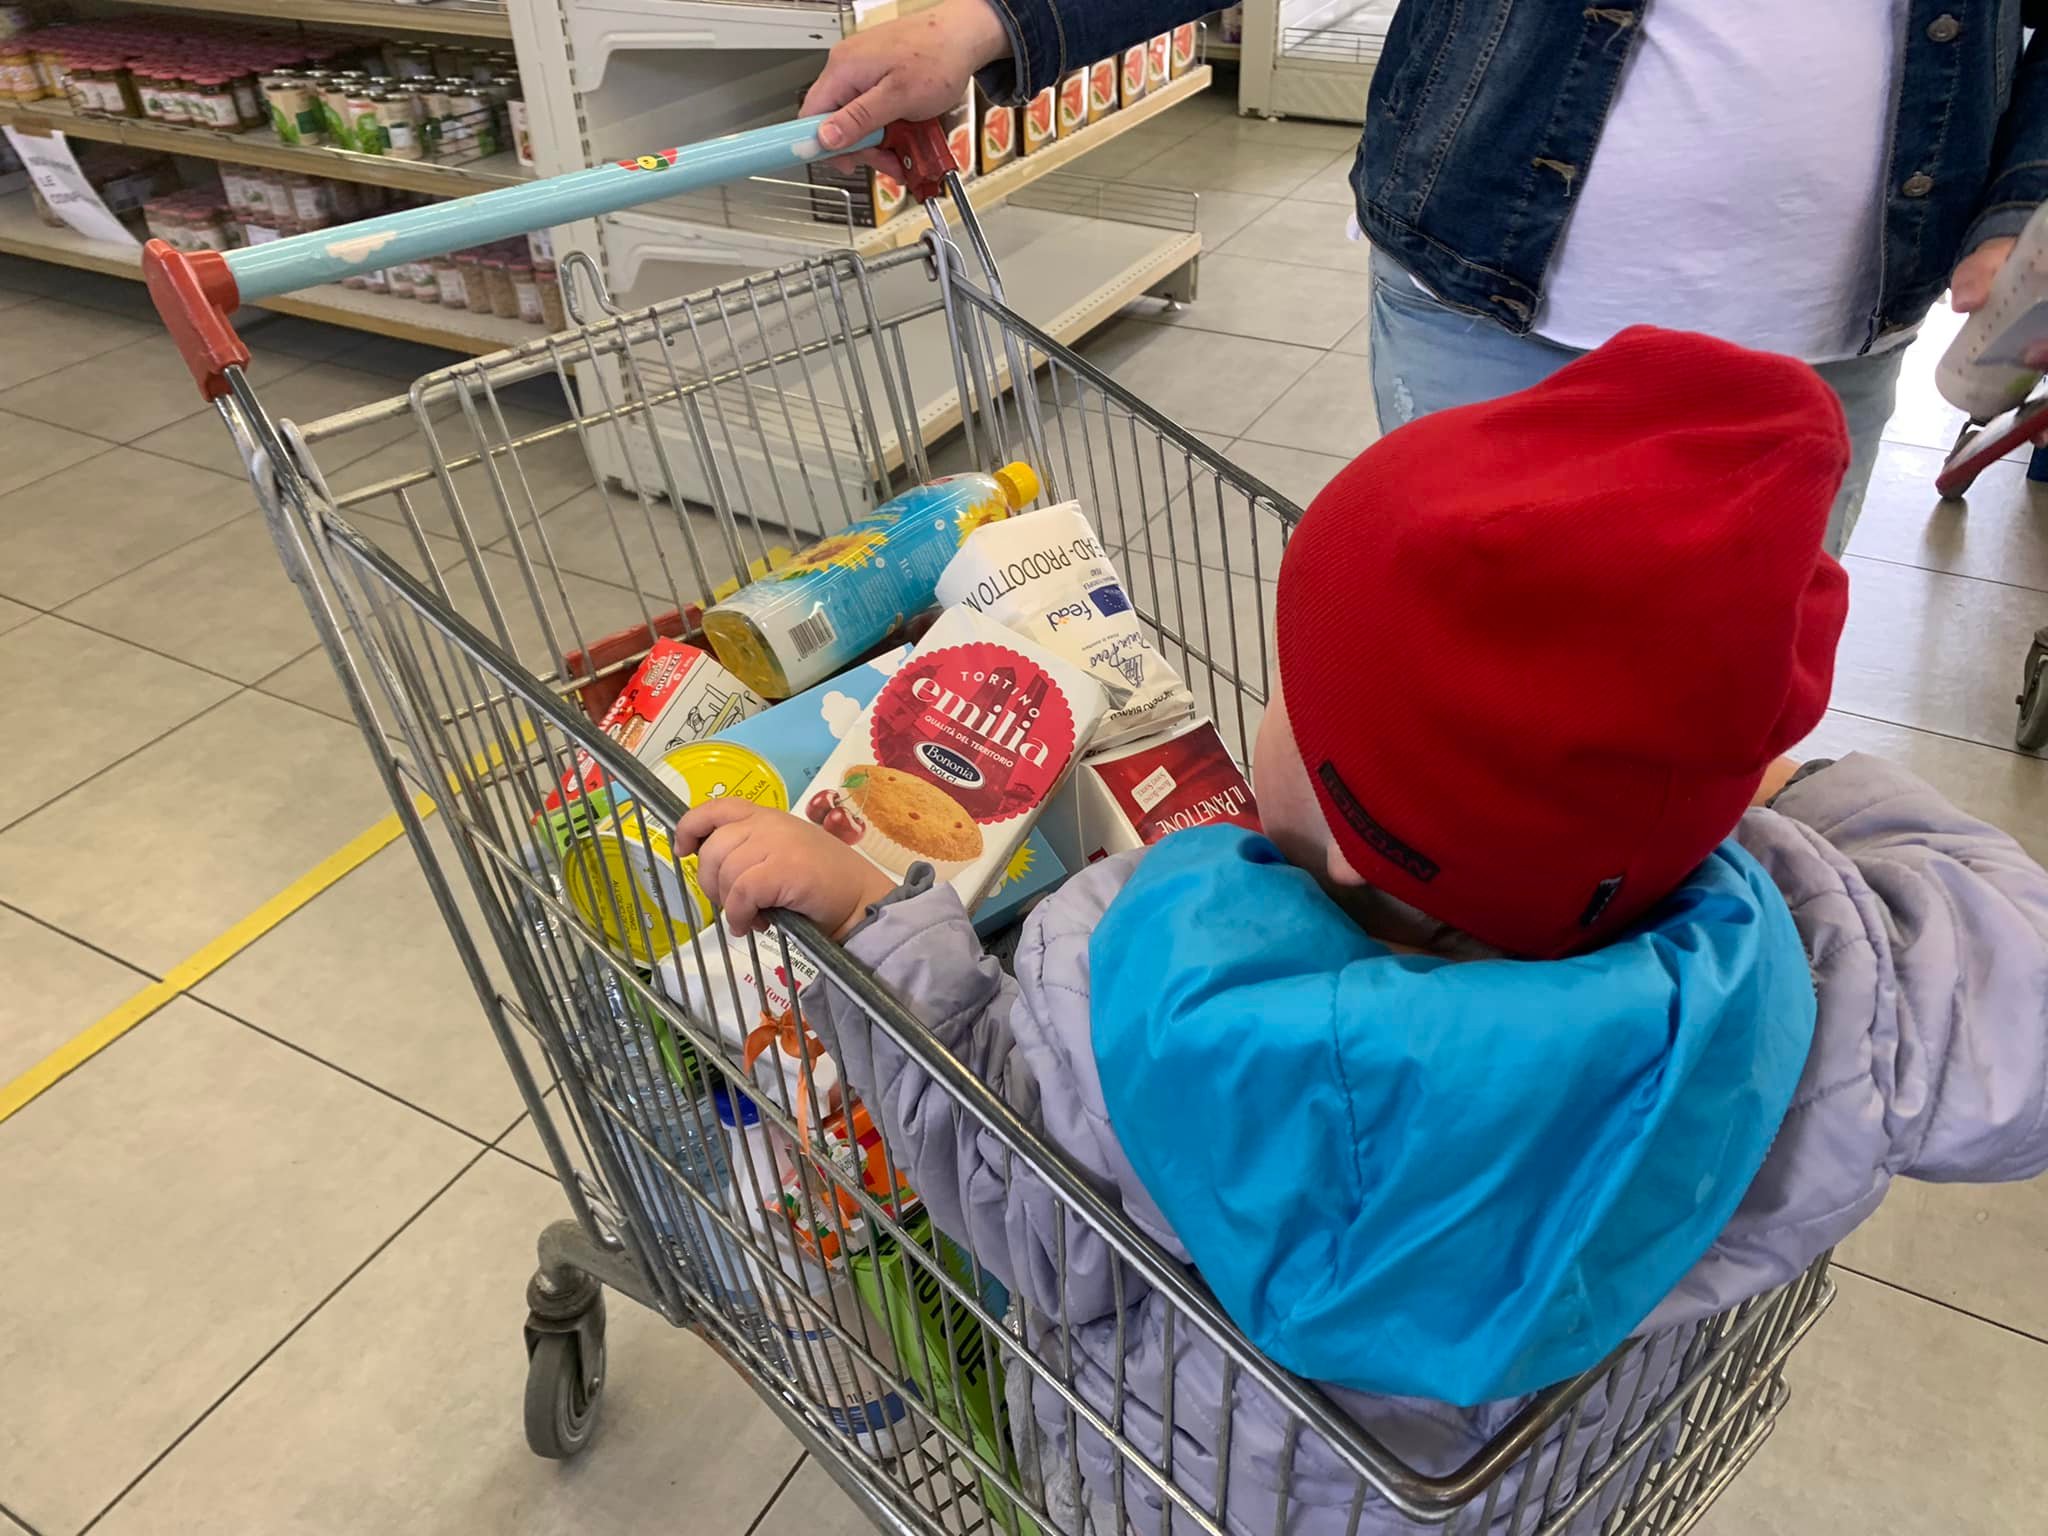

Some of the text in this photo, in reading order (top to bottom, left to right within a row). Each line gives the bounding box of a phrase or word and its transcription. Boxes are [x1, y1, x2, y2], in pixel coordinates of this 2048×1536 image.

[1046, 599, 1093, 632] fead
[650, 652, 682, 697] SQUEEZE
[960, 671, 1040, 718] TORTINO
[911, 677, 1049, 769] emilia
[924, 714, 1014, 768] QUALITÀ DEL TERRITORIO
[926, 745, 974, 780] Bononia
[929, 763, 958, 784] DOLCI
[745, 780, 767, 800] OLIVA
[1155, 785, 1247, 834] IL PANETTONE
